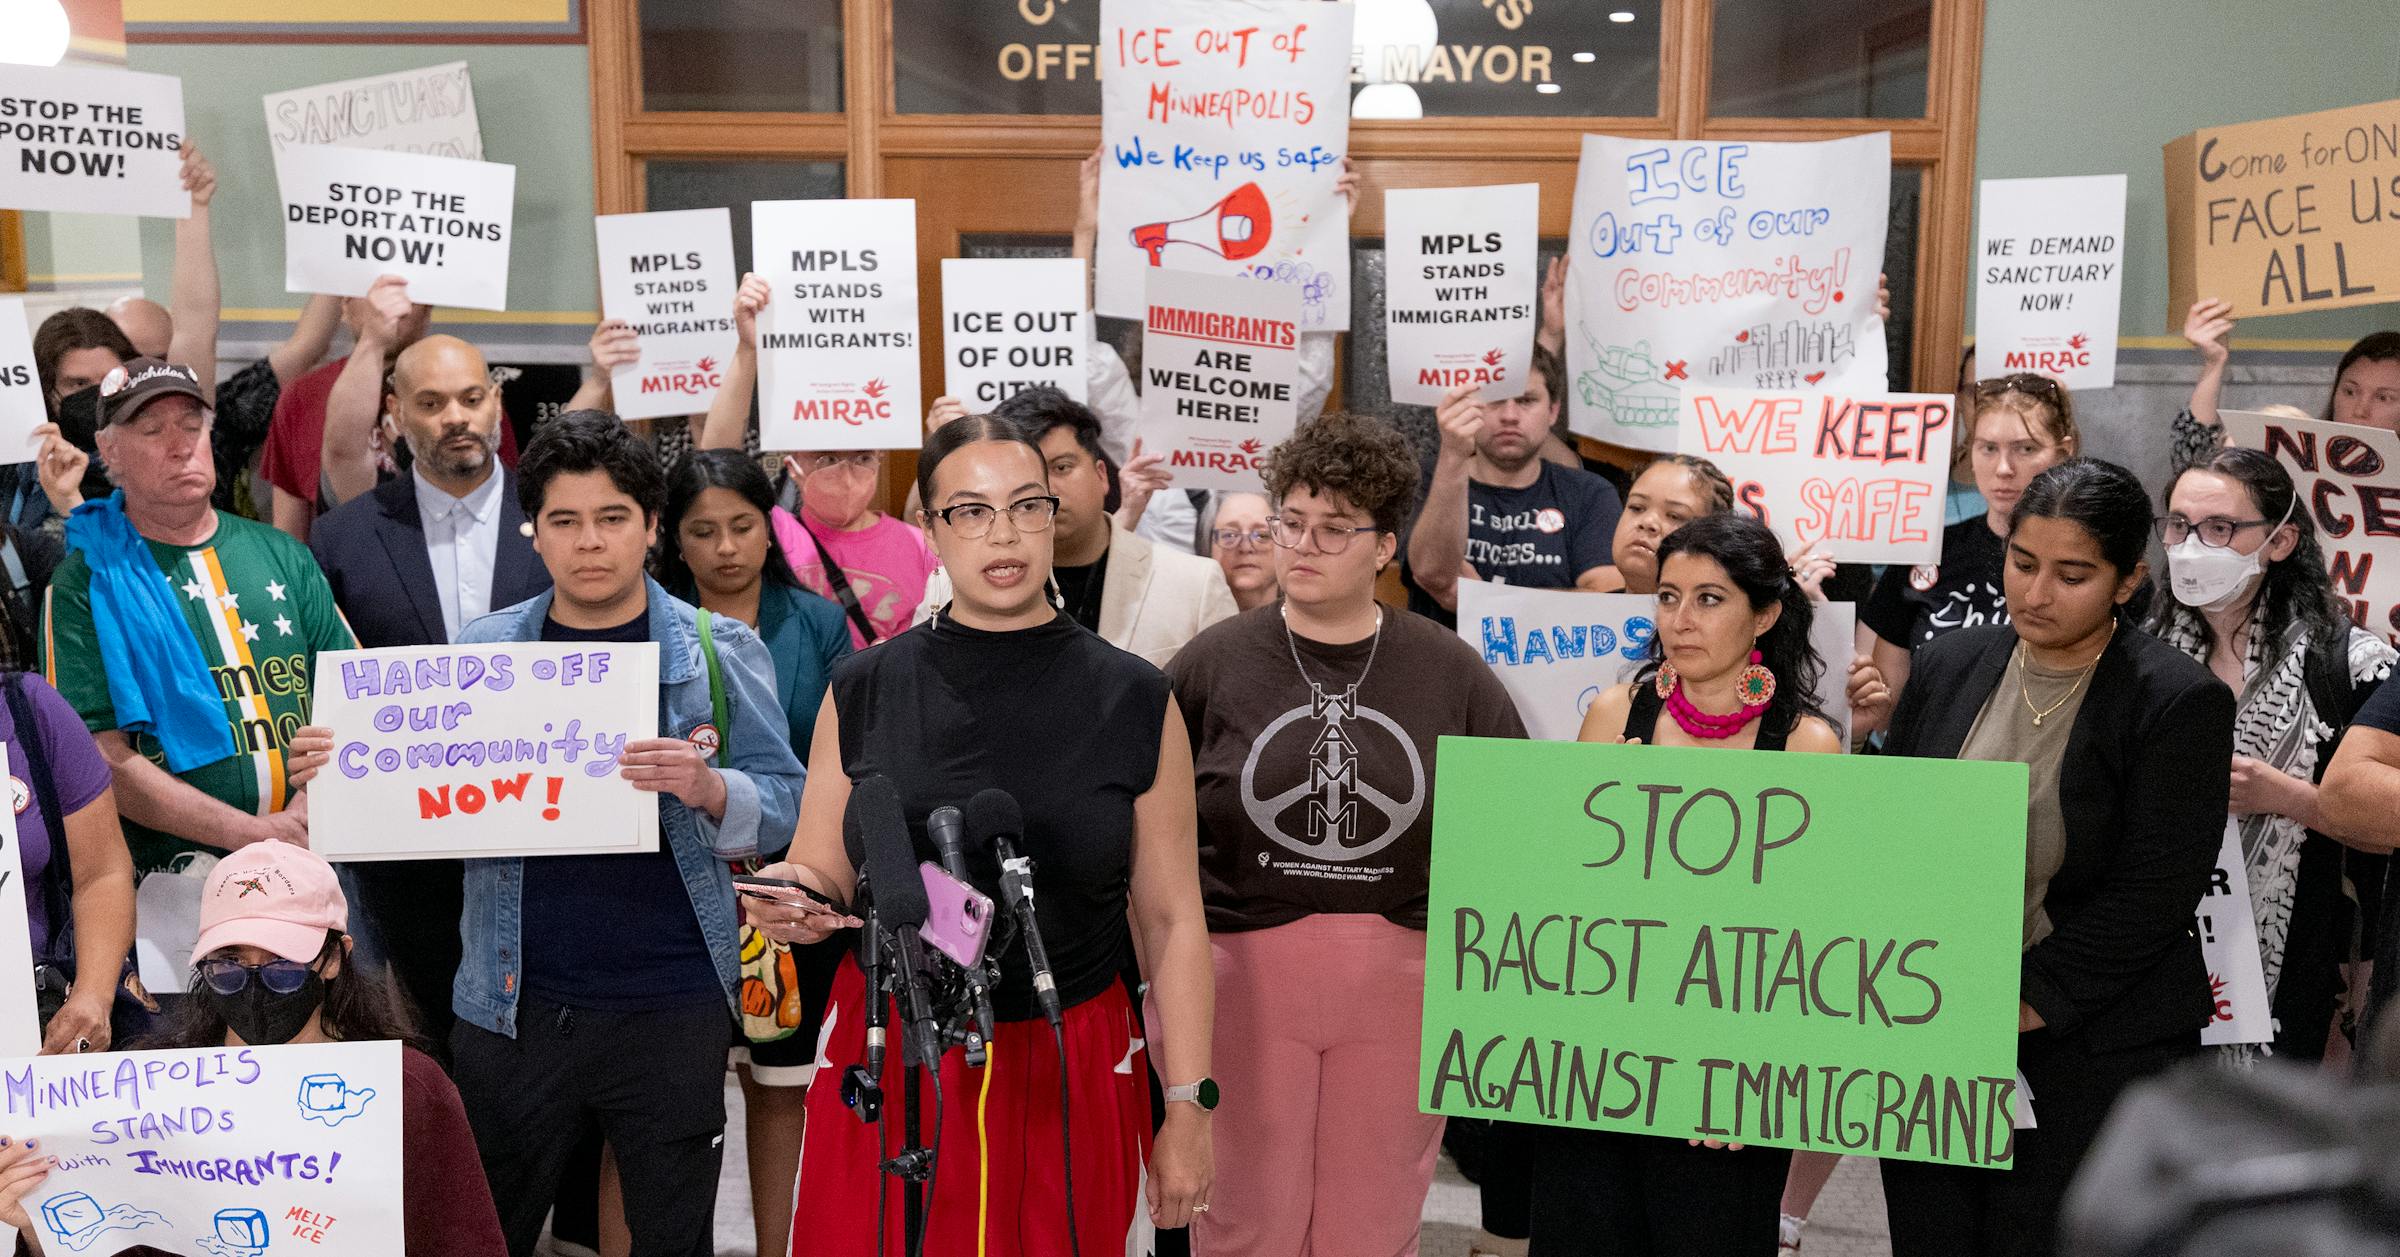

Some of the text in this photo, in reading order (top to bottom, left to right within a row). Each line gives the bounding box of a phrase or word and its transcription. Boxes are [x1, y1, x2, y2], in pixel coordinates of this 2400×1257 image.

[1119, 26, 1181, 67] ICE
[1383, 44, 1552, 83] MAYOR
[1, 98, 143, 125] STOP THE
[276, 67, 469, 145] SANCTUARY
[21, 148, 125, 178] NOW!
[1116, 135, 1164, 168] We
[2200, 137, 2287, 182] Come
[2301, 132, 2341, 168] for
[1627, 144, 1748, 206] ICE
[329, 183, 465, 213] STOP THE
[289, 204, 502, 241] DEPORTATIONS
[2208, 184, 2321, 245] FACE
[1421, 232, 1502, 255] MPLS
[1590, 211, 1681, 258] Out
[1694, 205, 1736, 246] of
[1987, 235, 2115, 256] WE DEMAND
[346, 234, 444, 266] NOW!
[630, 252, 702, 273] MPLS
[792, 249, 878, 272] MPLS
[1423, 262, 1505, 280] STANDS
[1986, 263, 2114, 285] SANCTUARY
[2261, 242, 2375, 306] ALL
[634, 280, 707, 295] STANDS
[794, 283, 882, 299] STANDS
[1435, 286, 1488, 301] WITH
[2020, 293, 2073, 312] NOW!
[647, 301, 694, 315] WITH
[808, 308, 865, 323] WITH
[953, 312, 1077, 333] ICE OUT
[1392, 304, 1529, 324] IMMIGRANTS!
[762, 332, 912, 349] IMMIGRANTS!
[1148, 305, 1296, 346] IMMIGRANTS
[959, 346, 1073, 368] OF OUR
[1194, 349, 1252, 373] ARE
[2004, 351, 2090, 373] MIRAC
[641, 373, 721, 394] MIRAC
[1149, 367, 1291, 402] WELCOME
[1418, 366, 1505, 387] MIRAC
[793, 399, 891, 426] MIRAC
[1177, 398, 1259, 424] HERE!
[1694, 395, 1949, 466] WE KEEP
[2265, 424, 2385, 478] NO
[1795, 476, 1933, 544] SAFE
[1482, 616, 1655, 666] HANDS
[341, 655, 515, 700] HANDS
[373, 702, 473, 732] our
[1309, 683, 1358, 839] WAMM
[418, 773, 564, 821] NOW!
[1582, 780, 1811, 884] STOP
[1300, 862, 1331, 871] AGAINST
[1332, 866, 1363, 874] MILITARY
[1454, 907, 1942, 1028] RACIST ATTACKS
[1430, 1028, 2016, 1167] AGAINST IMMIGRANTS
[127, 1150, 342, 1186] IMMIGRANTS!
[285, 1205, 336, 1230] MELT
[292, 1225, 324, 1245] ICE
